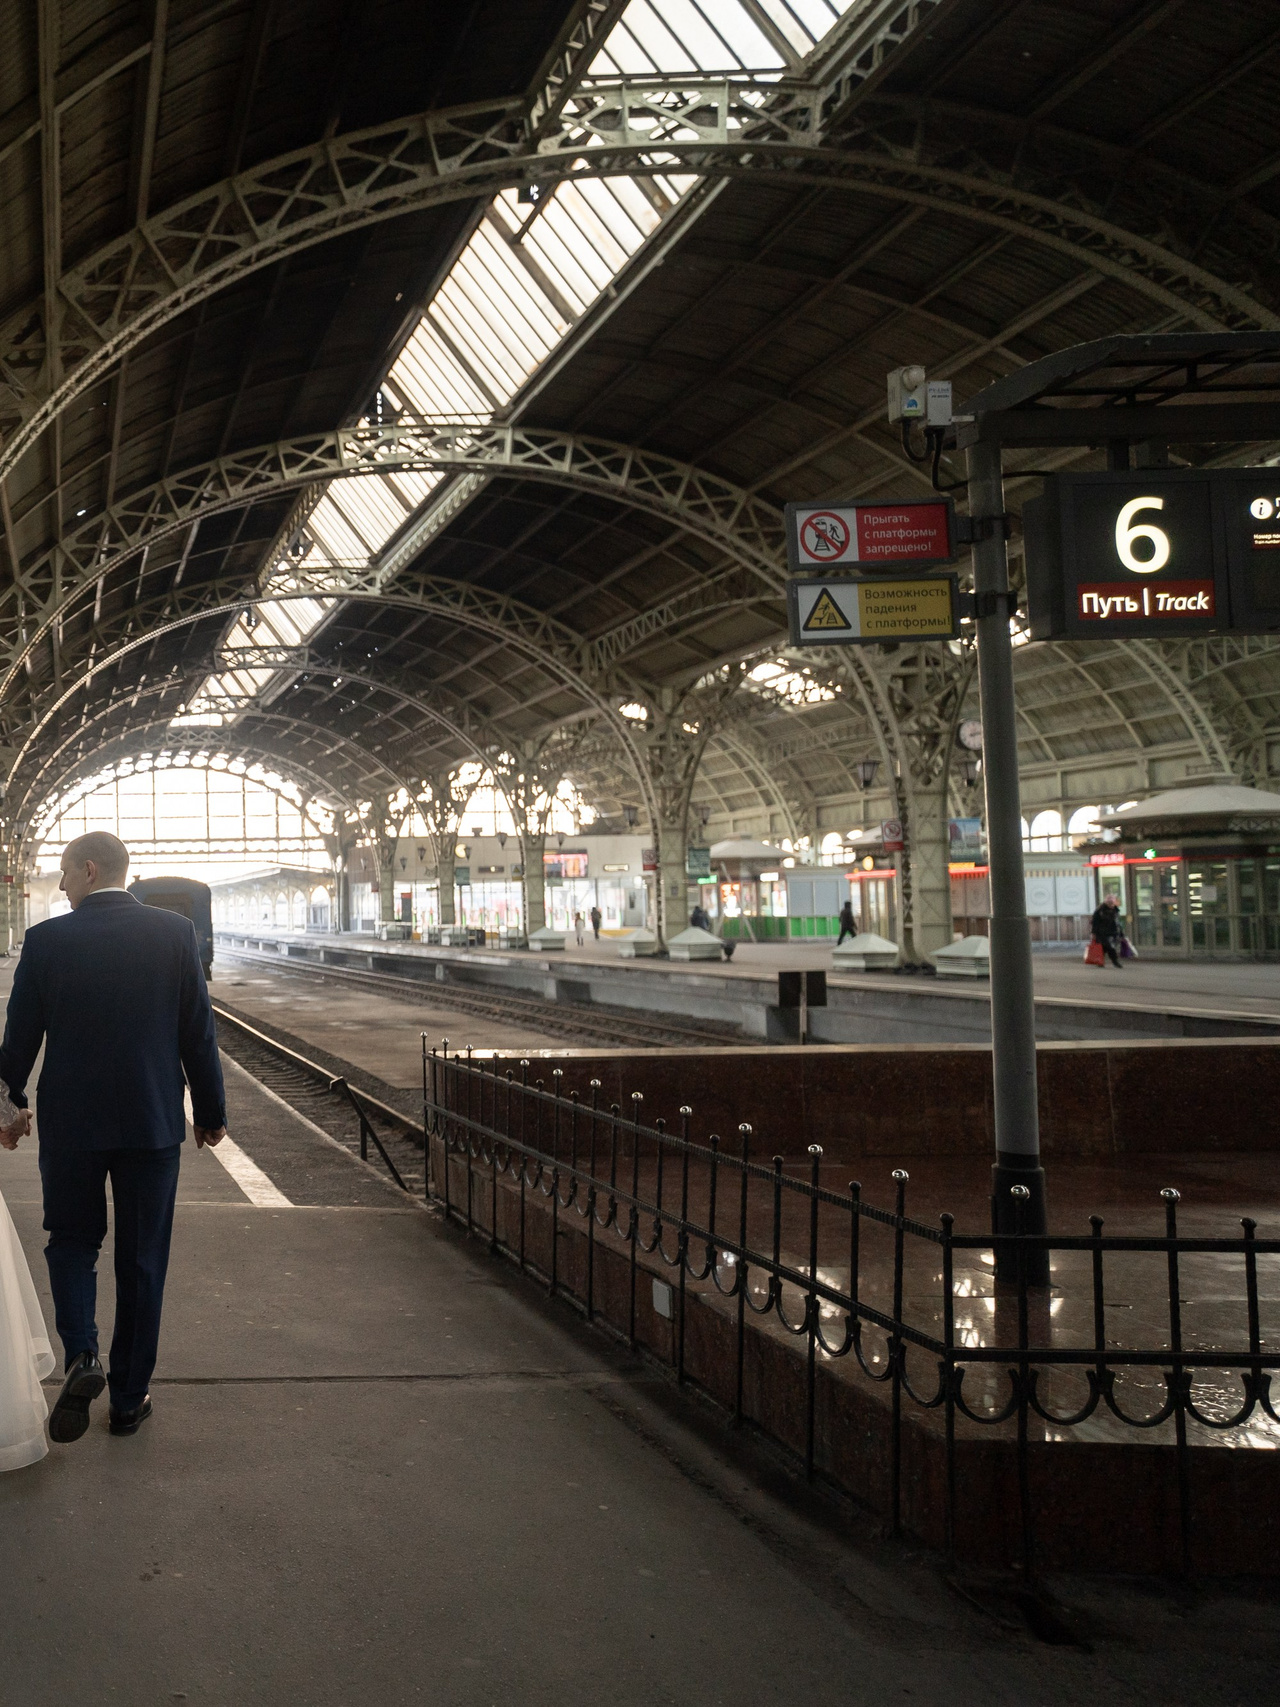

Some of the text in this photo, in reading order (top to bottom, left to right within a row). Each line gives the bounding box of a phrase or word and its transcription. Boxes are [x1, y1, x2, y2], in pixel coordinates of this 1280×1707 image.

[863, 514, 910, 525] Прыгать
[864, 528, 937, 541] с платформы
[1114, 496, 1171, 574] 6
[865, 543, 932, 555] запрещено!
[865, 589, 947, 600] Возможность
[865, 604, 917, 615] падения
[1081, 591, 1210, 618] Путь Track
[866, 615, 951, 629] с платформы!
